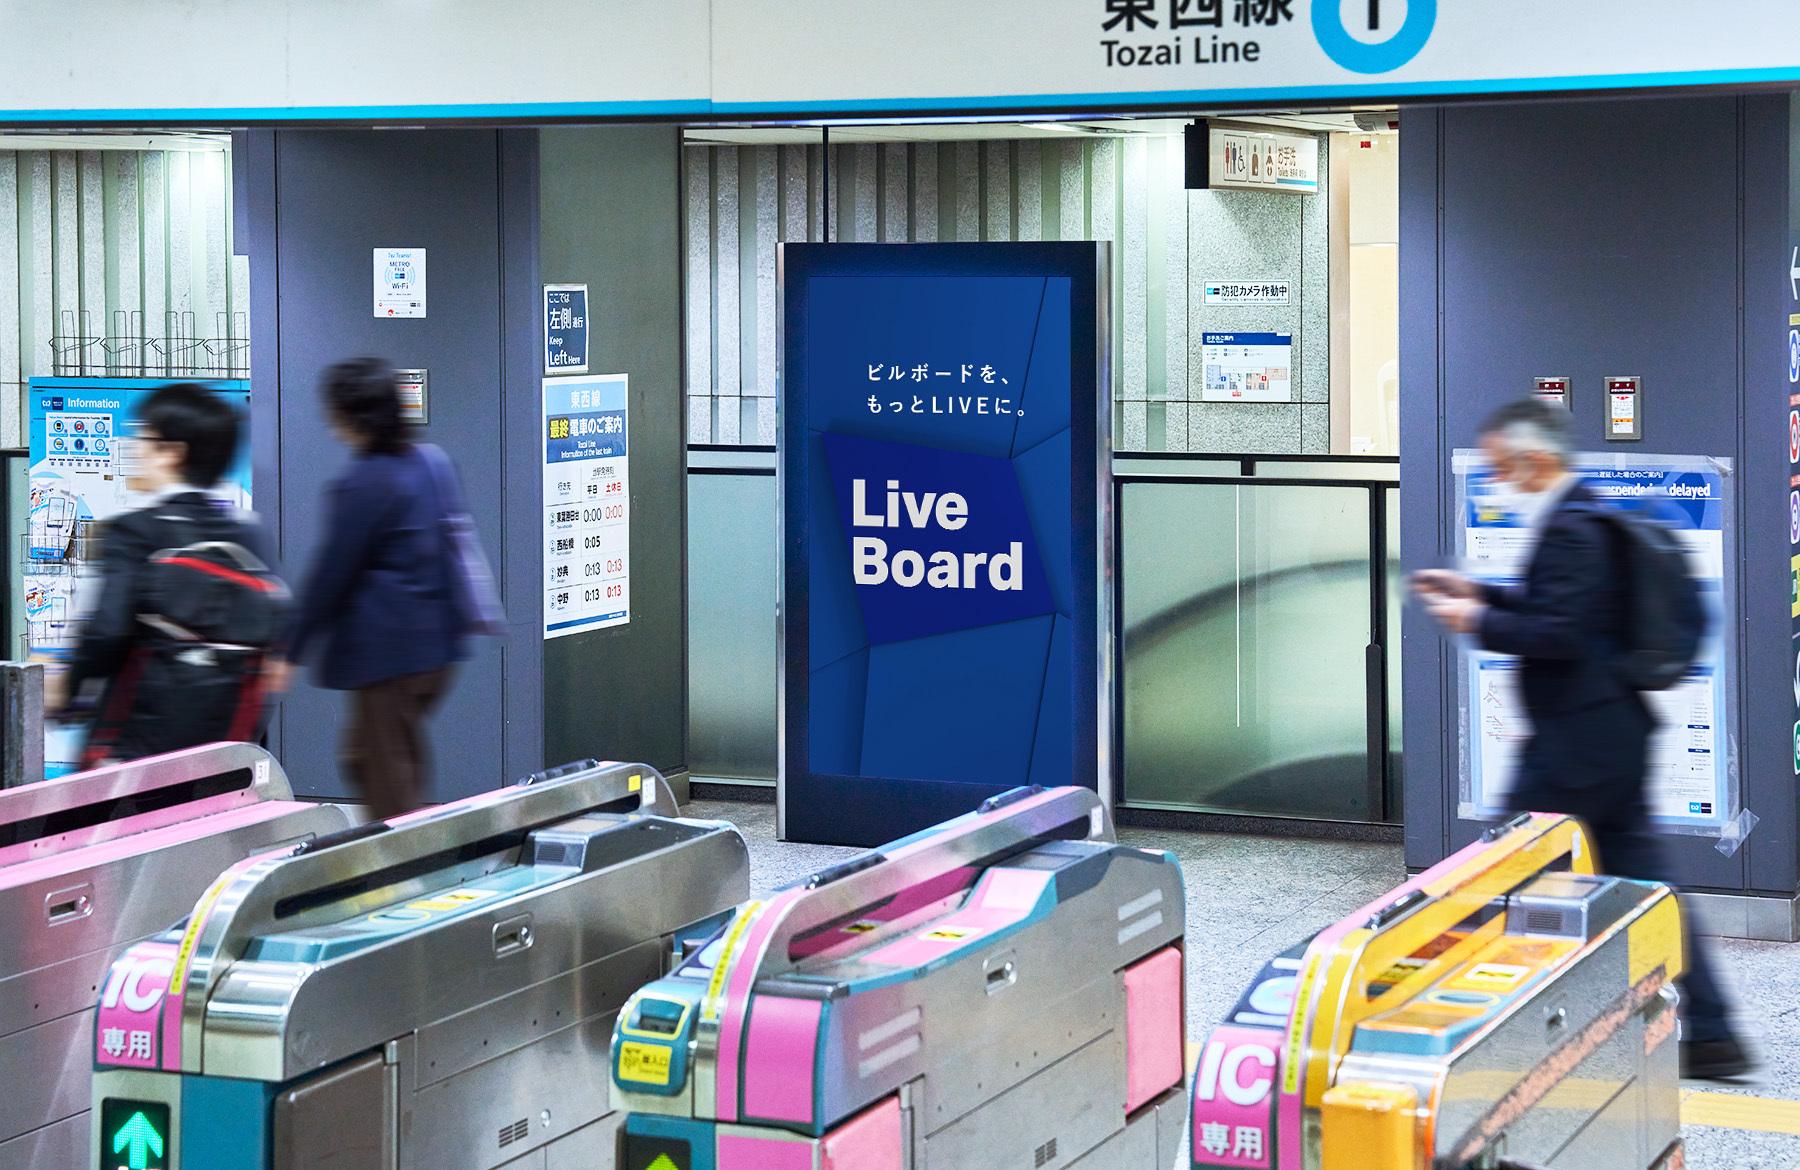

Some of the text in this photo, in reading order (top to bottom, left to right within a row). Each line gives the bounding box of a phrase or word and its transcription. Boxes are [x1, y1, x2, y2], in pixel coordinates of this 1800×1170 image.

[1101, 0, 1293, 32] 東西線
[1100, 34, 1260, 67] Tozai Line
[549, 293, 569, 303] ここでは
[1221, 285, 1287, 297] 防犯カメラ作動中
[549, 336, 563, 347] Keep
[549, 350, 581, 366] Left Here
[868, 363, 1009, 385] ビルボードを、
[67, 398, 120, 409] Information
[571, 390, 600, 409] 東西線
[867, 395, 1025, 417] もっとLIVEに。
[550, 416, 623, 438] 最終電車のご案内
[587, 484, 598, 494] 平日
[1668, 483, 1710, 500] delayed
[584, 508, 602, 522] 0:00
[605, 505, 623, 519] 0:00
[853, 479, 968, 530] Live
[584, 536, 600, 549] 0:05
[584, 562, 600, 576] 0:13
[607, 559, 622, 573] 0:13
[853, 536, 1023, 591] Board
[557, 592, 568, 604] 中野
[584, 588, 599, 602] 0:13
[607, 584, 621, 598] 0:13
[103, 957, 172, 1013] IC
[102, 1027, 152, 1060] 専用
[1198, 1040, 1276, 1106] IC
[1200, 1121, 1262, 1160] 専用
